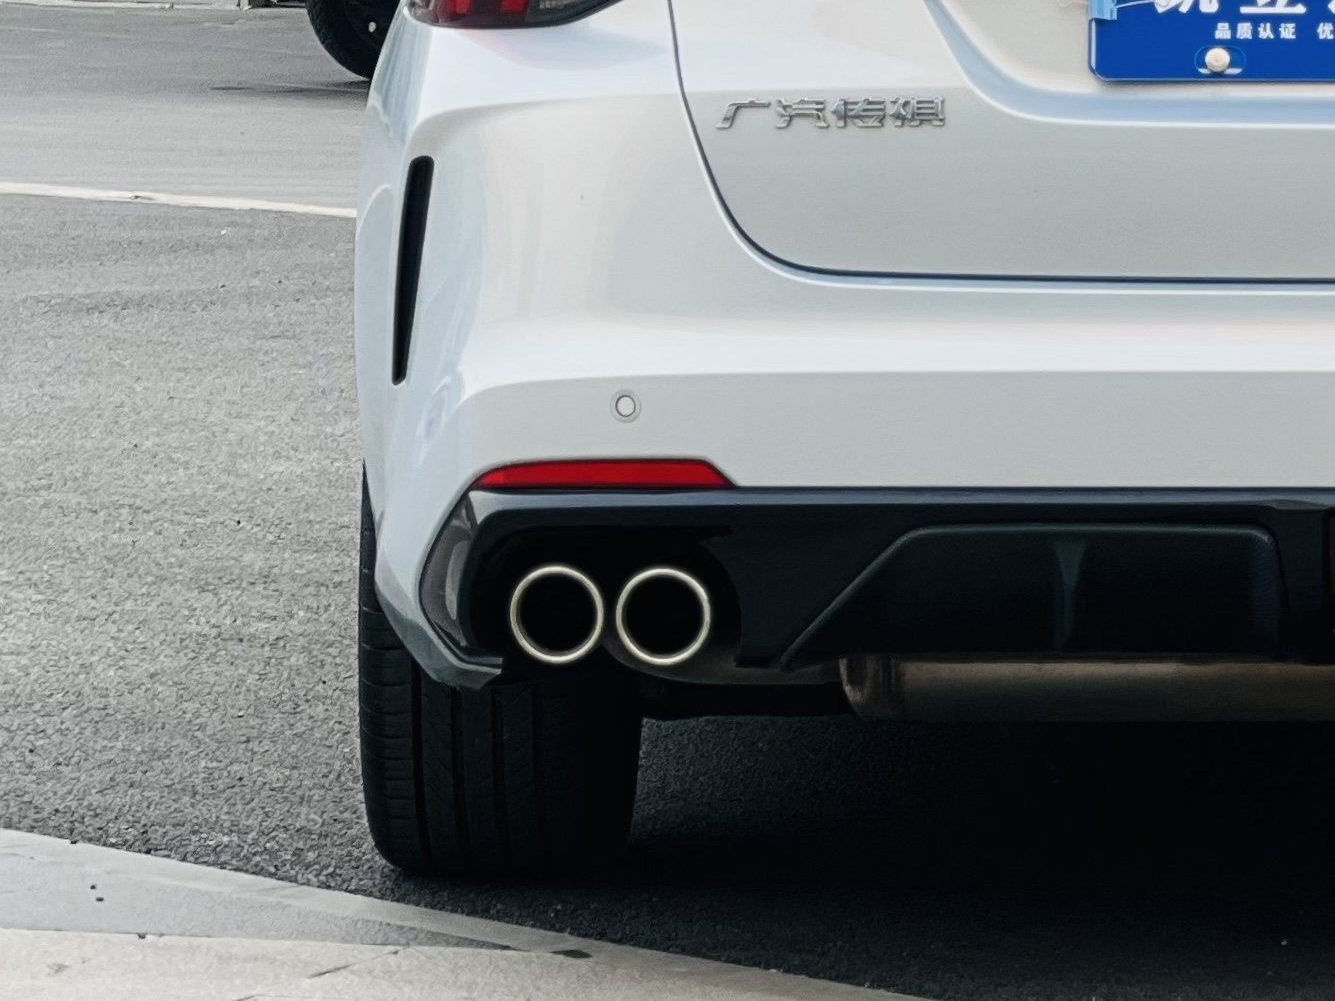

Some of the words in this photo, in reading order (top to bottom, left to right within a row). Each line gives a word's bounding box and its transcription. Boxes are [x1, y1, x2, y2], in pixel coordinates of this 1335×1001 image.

[1215, 22, 1298, 40] 品质认证
[715, 97, 946, 129] 广汽传祺
